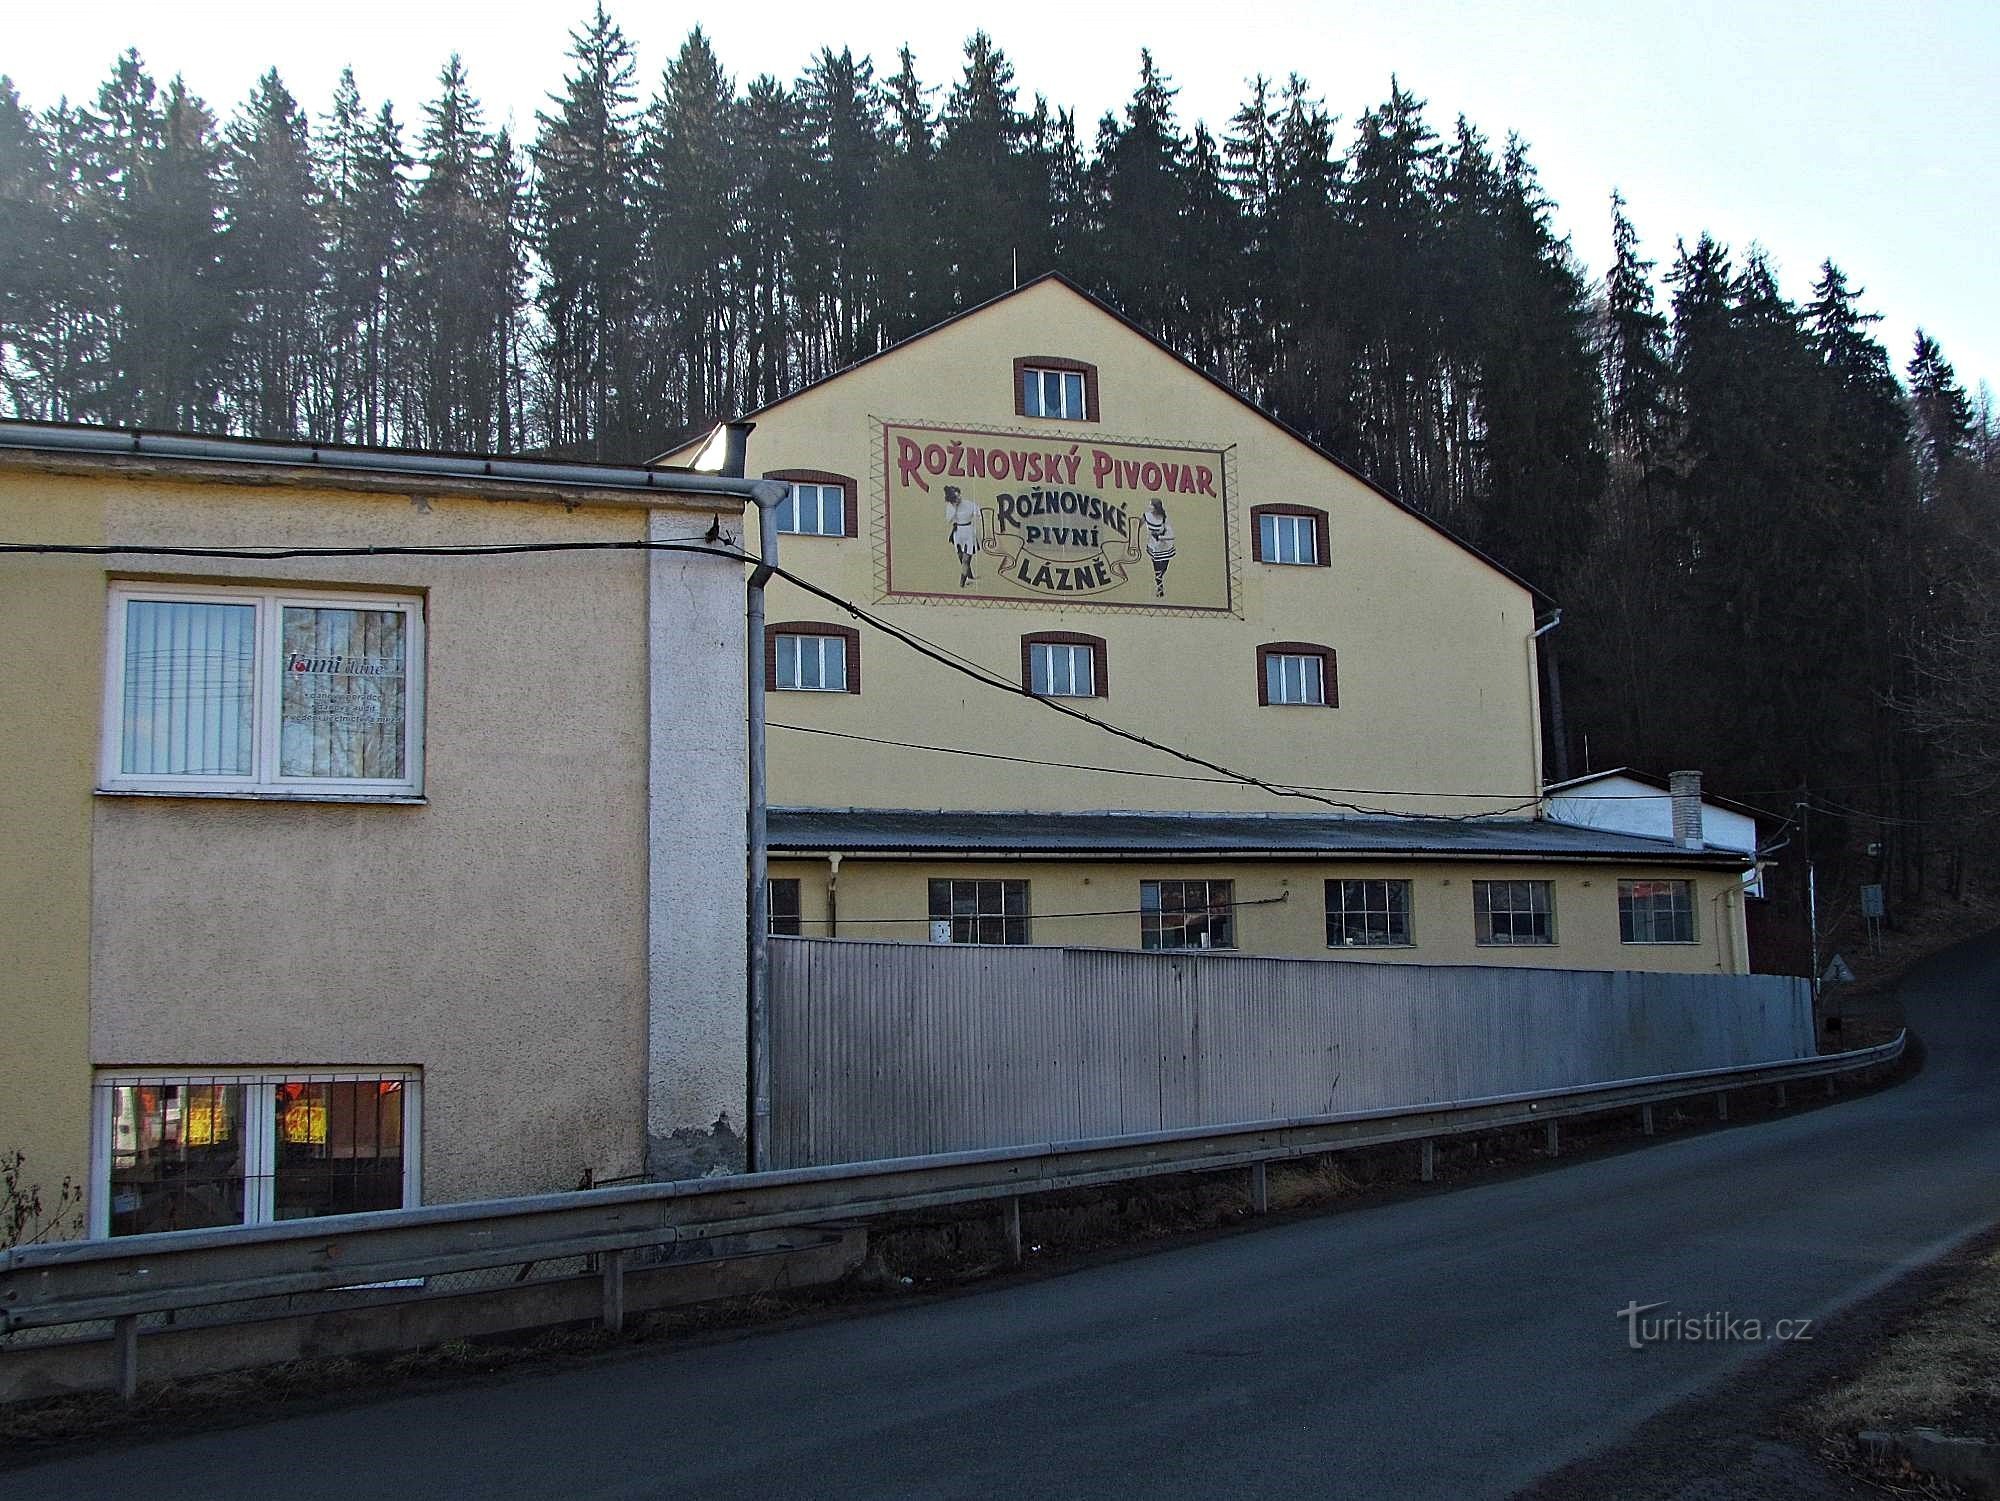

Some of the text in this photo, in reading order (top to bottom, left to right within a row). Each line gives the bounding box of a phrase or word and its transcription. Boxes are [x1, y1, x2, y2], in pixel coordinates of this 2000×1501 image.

[897, 436, 1217, 498] ROŽNOVSKÝ PIVOVAR
[996, 487, 1128, 537] ROŽNOVSKÉ
[1026, 525, 1099, 547] PIVNÍ
[1017, 558, 1112, 591] LÁZNĚ
